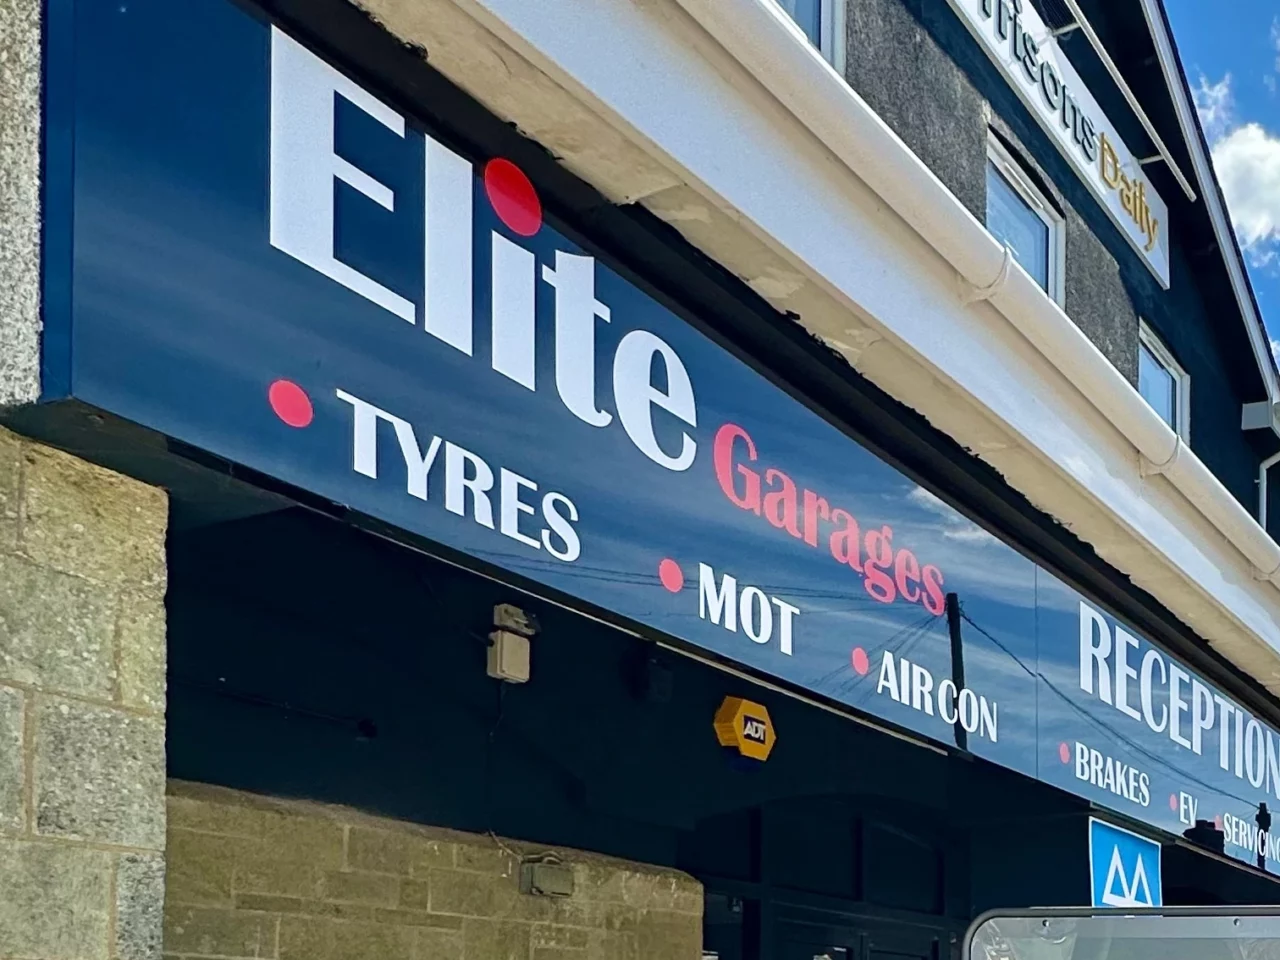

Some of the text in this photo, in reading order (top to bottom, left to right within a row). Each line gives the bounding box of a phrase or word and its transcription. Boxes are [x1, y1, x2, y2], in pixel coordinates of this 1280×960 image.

[1101, 132, 1159, 252] Daily
[269, 24, 697, 471] Elite
[336, 388, 581, 562] TYRES
[713, 422, 946, 616] Garages
[699, 562, 800, 656] MOT
[743, 720, 766, 741] ADT
[1075, 741, 1150, 807] BRAKES
[1179, 790, 1198, 828] EV
